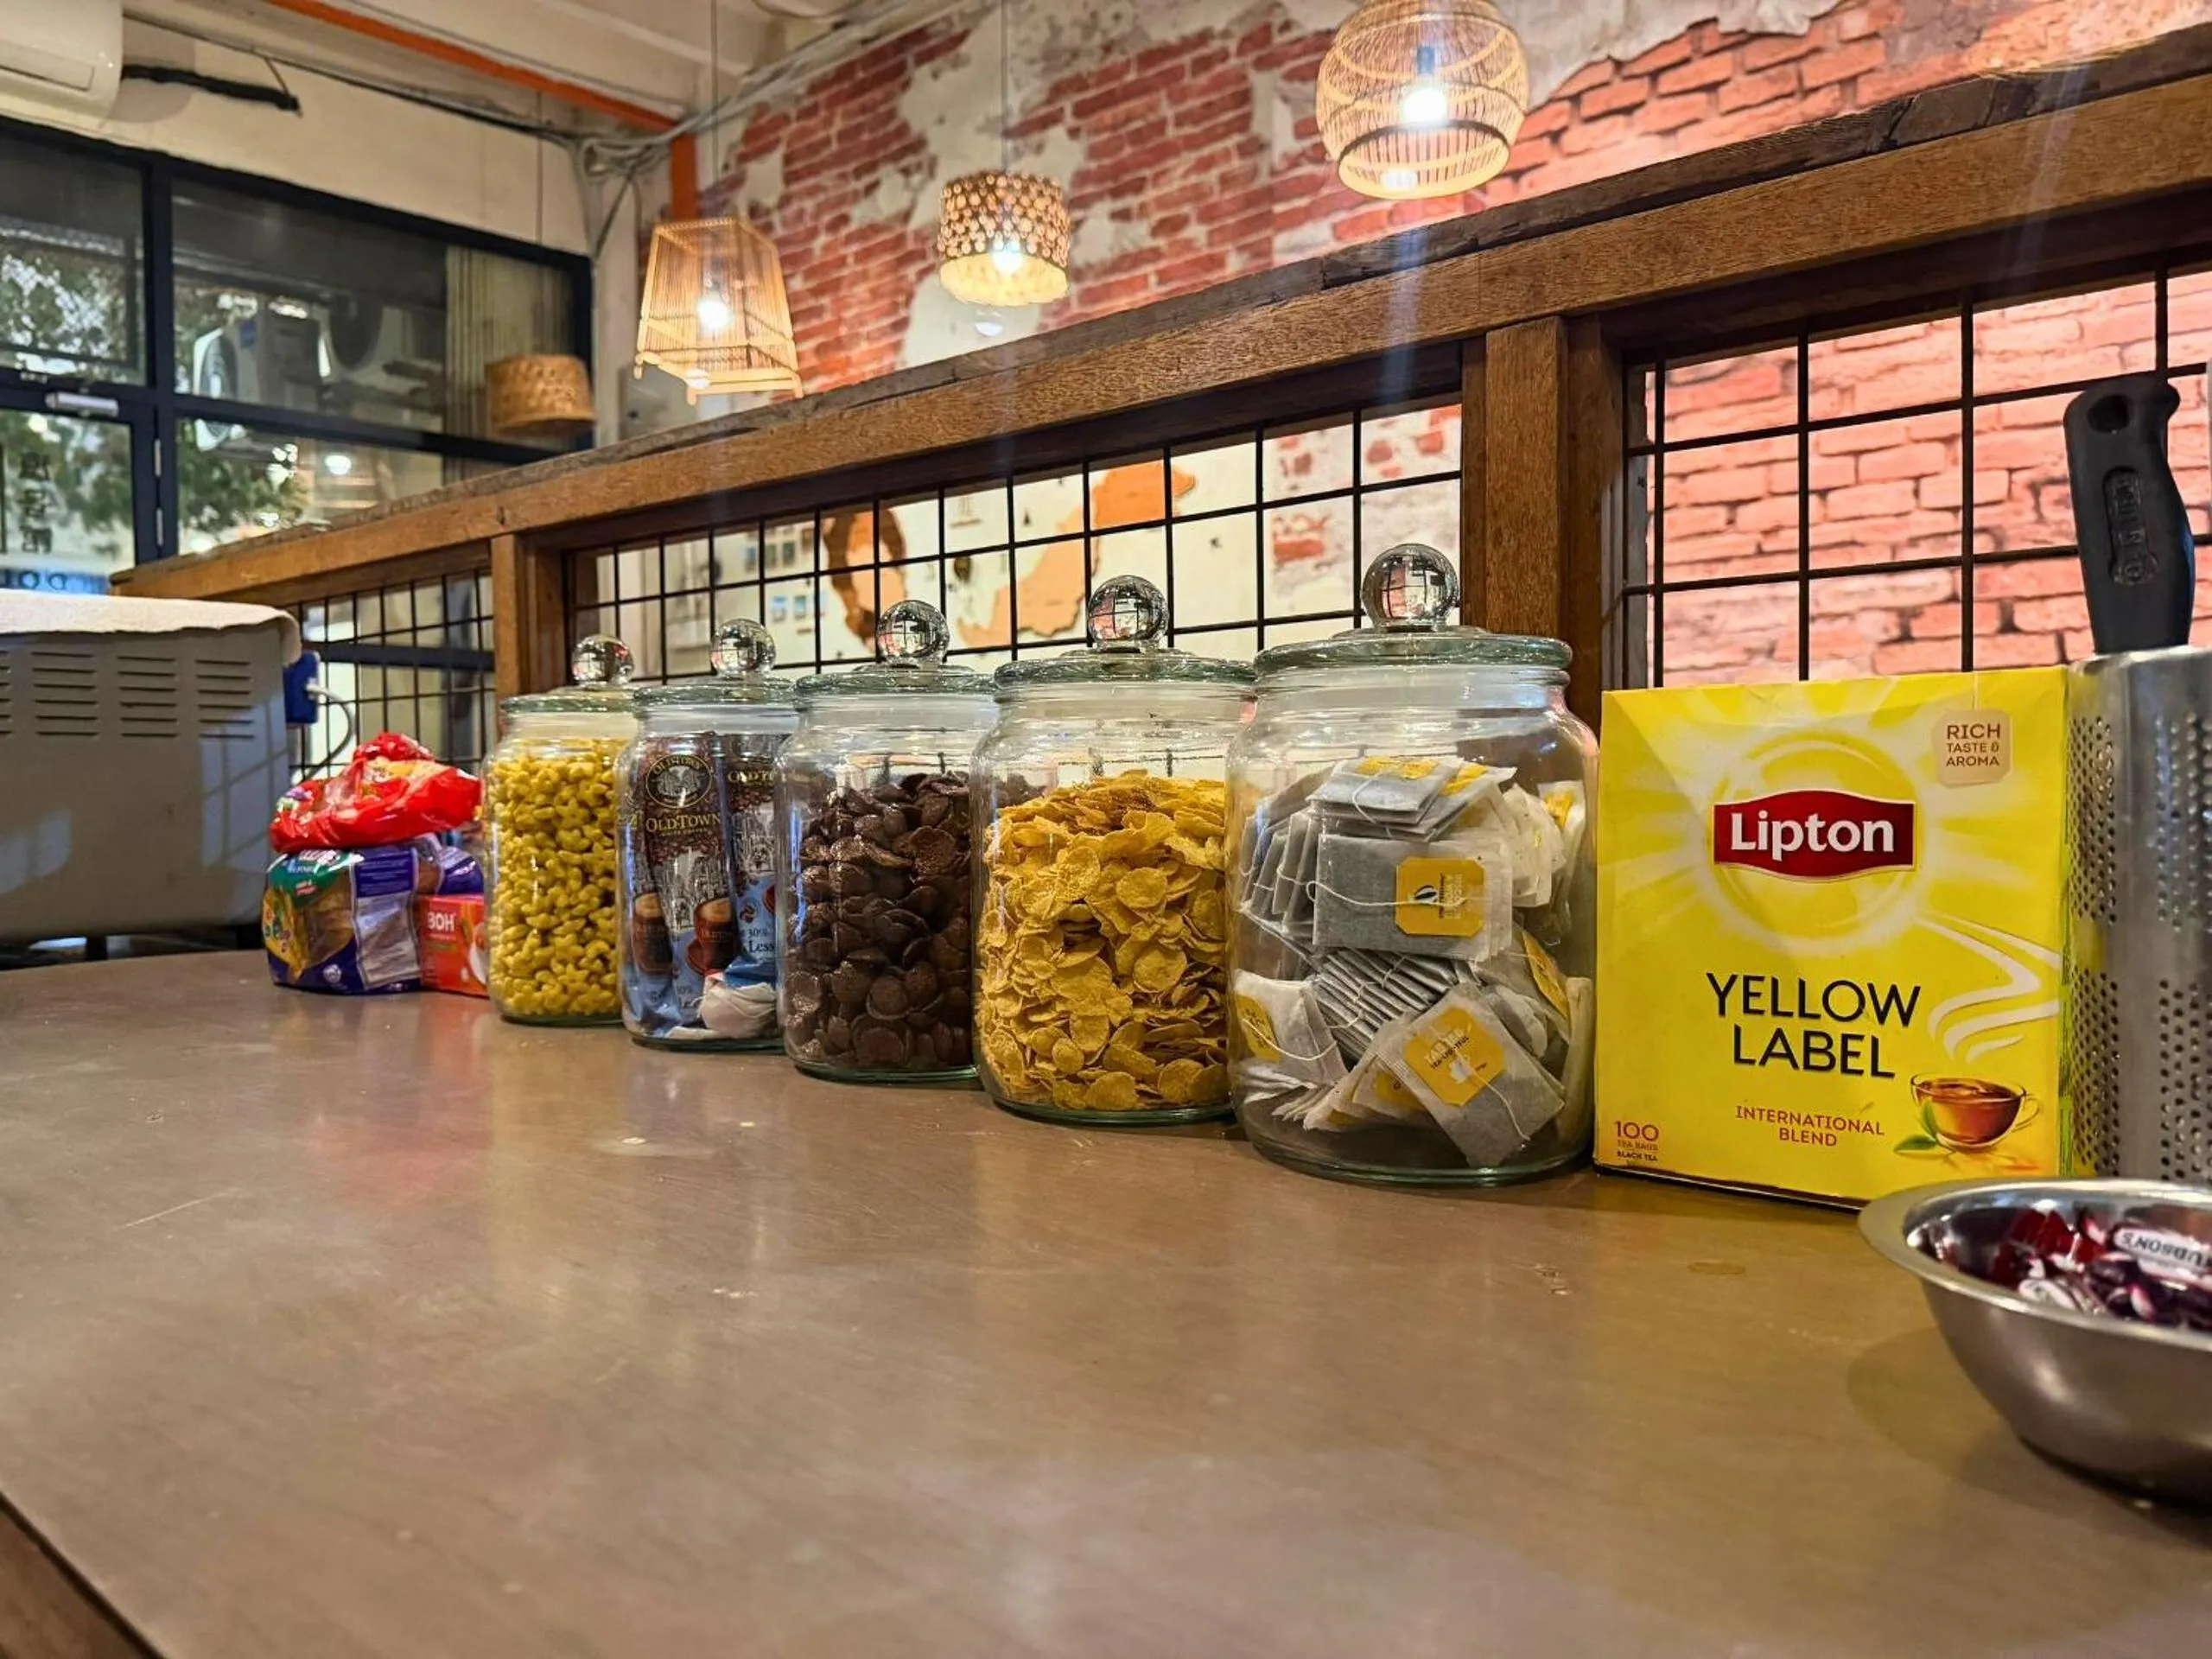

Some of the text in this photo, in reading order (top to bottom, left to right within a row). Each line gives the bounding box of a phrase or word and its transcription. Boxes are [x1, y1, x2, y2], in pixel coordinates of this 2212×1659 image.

[1947, 722, 2001, 740] RICH
[1946, 742, 1987, 753] TASTE
[1946, 755, 2000, 767] AROMA
[1730, 812, 1895, 861] Lipton
[427, 911, 455, 931] BOH
[1706, 972, 1922, 1028] YELLOW
[1733, 1024, 1896, 1079] LABEL
[1736, 1105, 1885, 1135] INTERNATIONAL
[1615, 1121, 1660, 1141] 100
[1778, 1127, 1838, 1147] BLEND
